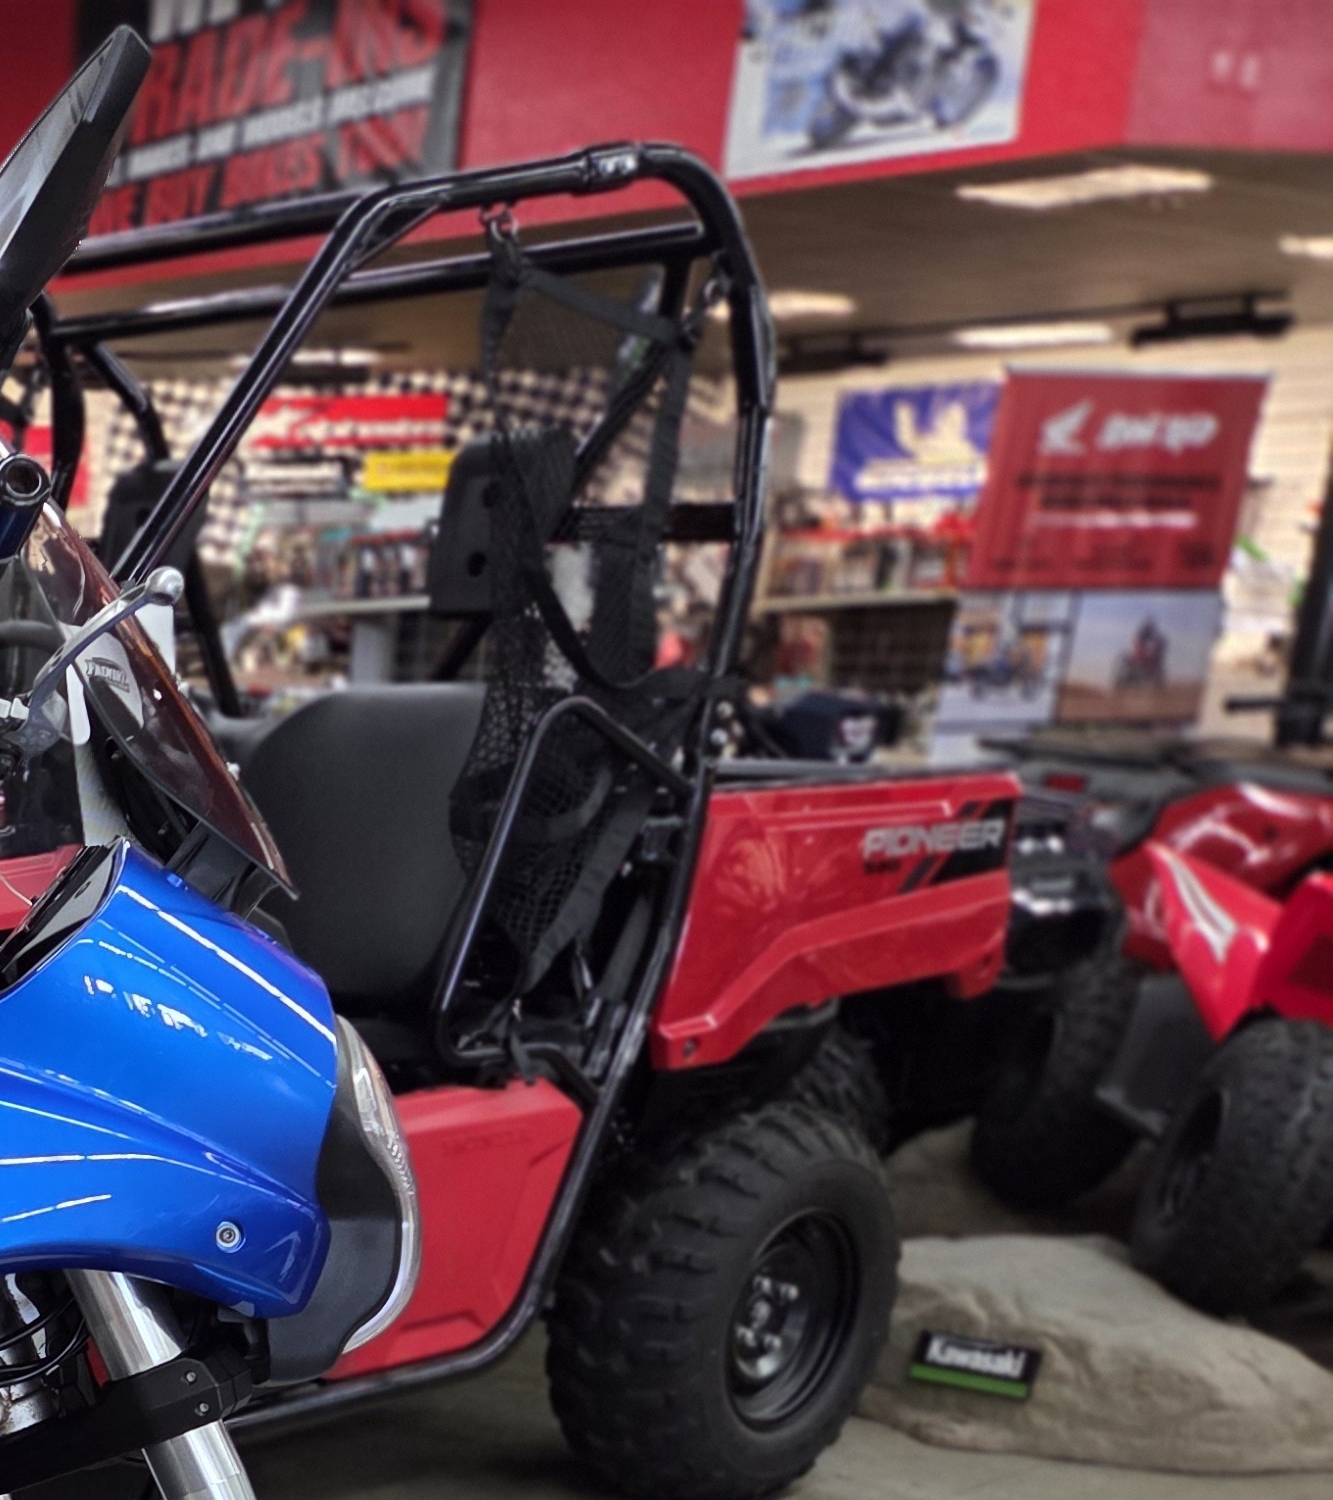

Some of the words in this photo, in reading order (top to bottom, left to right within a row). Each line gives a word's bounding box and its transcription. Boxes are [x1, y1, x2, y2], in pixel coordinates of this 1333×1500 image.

[125, 0, 445, 150] RADE-INS
[863, 817, 1006, 859] PIONEER
[925, 1335, 1027, 1379] Kawasaki
